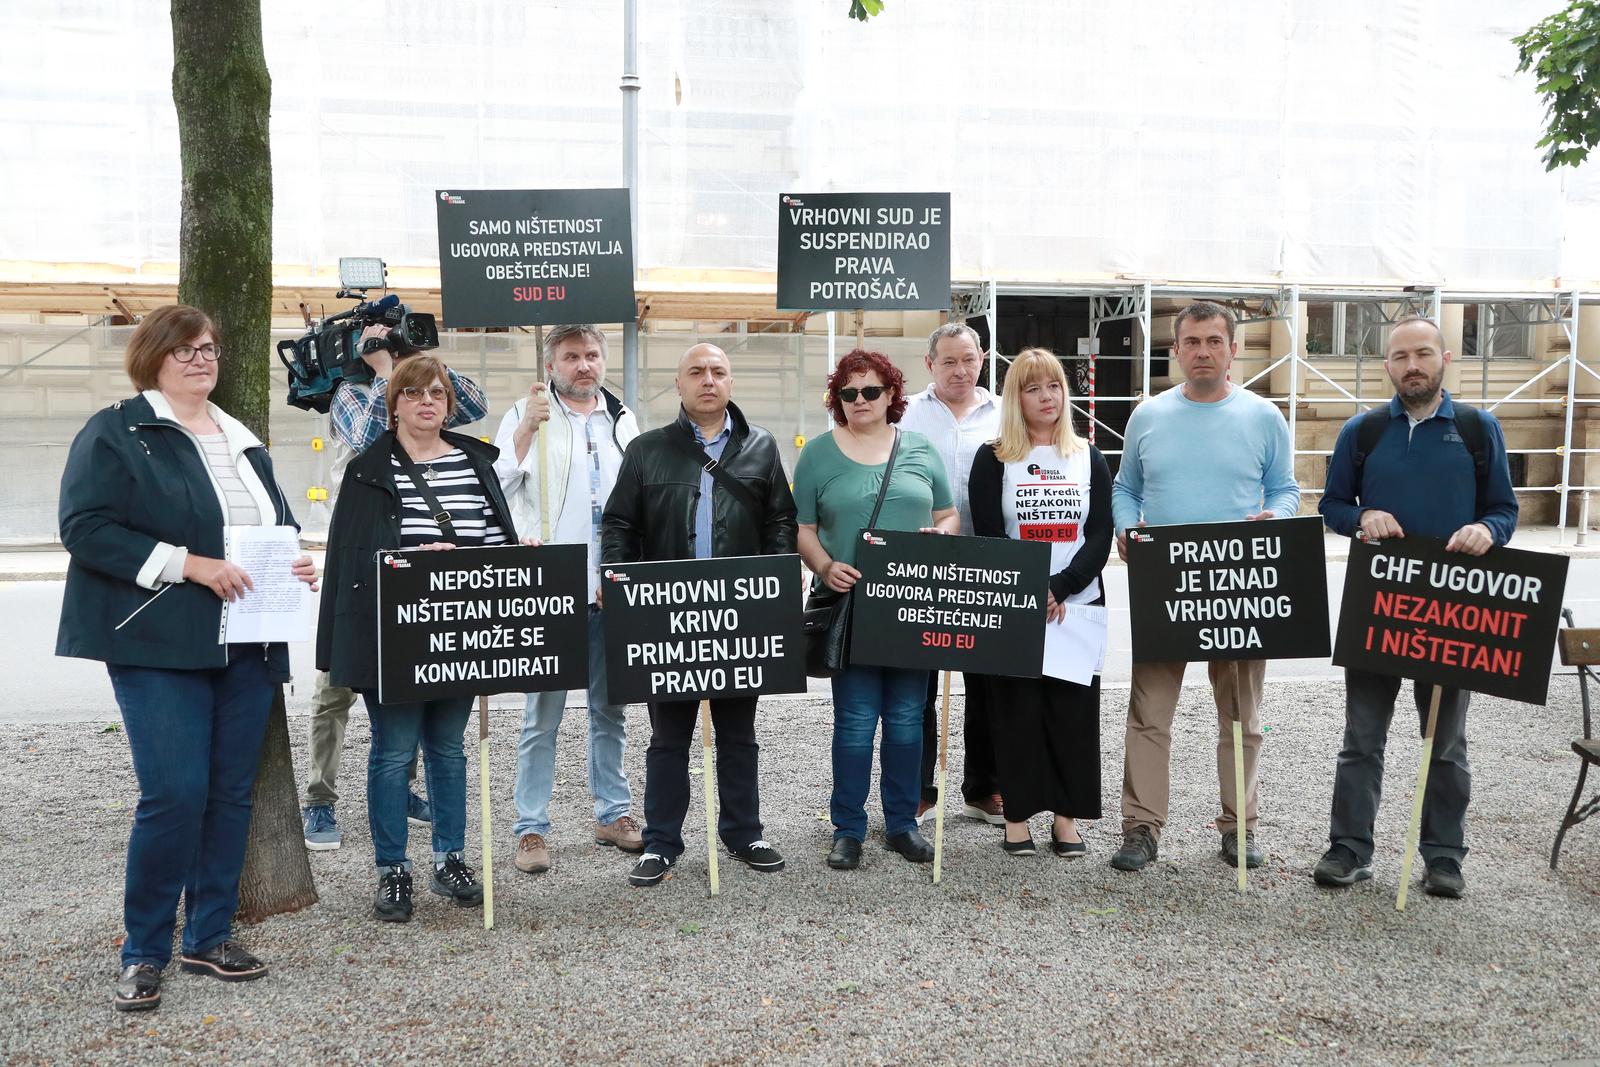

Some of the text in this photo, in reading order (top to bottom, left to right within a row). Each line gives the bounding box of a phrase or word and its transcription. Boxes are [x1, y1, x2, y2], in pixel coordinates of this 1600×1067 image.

[469, 216, 602, 236] SAMO NIŠTETNOST
[789, 207, 942, 226] VRHOVNI SUD JE
[450, 240, 623, 258] UGOVORA PREDSTAVLJA
[800, 232, 930, 250] SUSPENDIRAO
[486, 261, 590, 280] OBEŠTEĆENJE!
[835, 257, 895, 275] PRAVA
[513, 286, 566, 301] SUD EU
[810, 277, 920, 300] POTROŠAČA
[1016, 488, 1080, 498] CHF Kredit
[1016, 499, 1082, 509] NEZAKONIT
[1017, 509, 1082, 521] NIŠTETAN
[1028, 528, 1073, 538] SUD EU
[1169, 536, 1281, 564] PRAVO EU
[430, 564, 543, 591] NEPOŠTEN I
[887, 562, 1021, 586] SAMO NIŠTETNOST
[1175, 566, 1278, 593] JE IZNAD
[1370, 554, 1542, 604] CHF UGOVOR
[623, 576, 780, 607] VRHOVNI SUD
[866, 583, 1038, 610] UGOVORA PREDSTAVLJA
[397, 596, 575, 624] NIŠTETAN UGOVOR
[897, 606, 1002, 629] OBEŠTEĆENJE!
[1165, 595, 1292, 622] VRHOVNOG
[1373, 591, 1528, 639] NEZAKONIT
[670, 608, 738, 634] KRIVO
[430, 624, 545, 652] NE MOŽE SE
[922, 632, 976, 650] SUD EU
[1198, 626, 1263, 650] SUDA
[627, 635, 785, 667] PRIMJENJUJE
[1365, 626, 1523, 678] I NIŠTETAN!
[415, 656, 559, 684] KONVALIDIRATI
[651, 666, 763, 695] PRAVO EU
